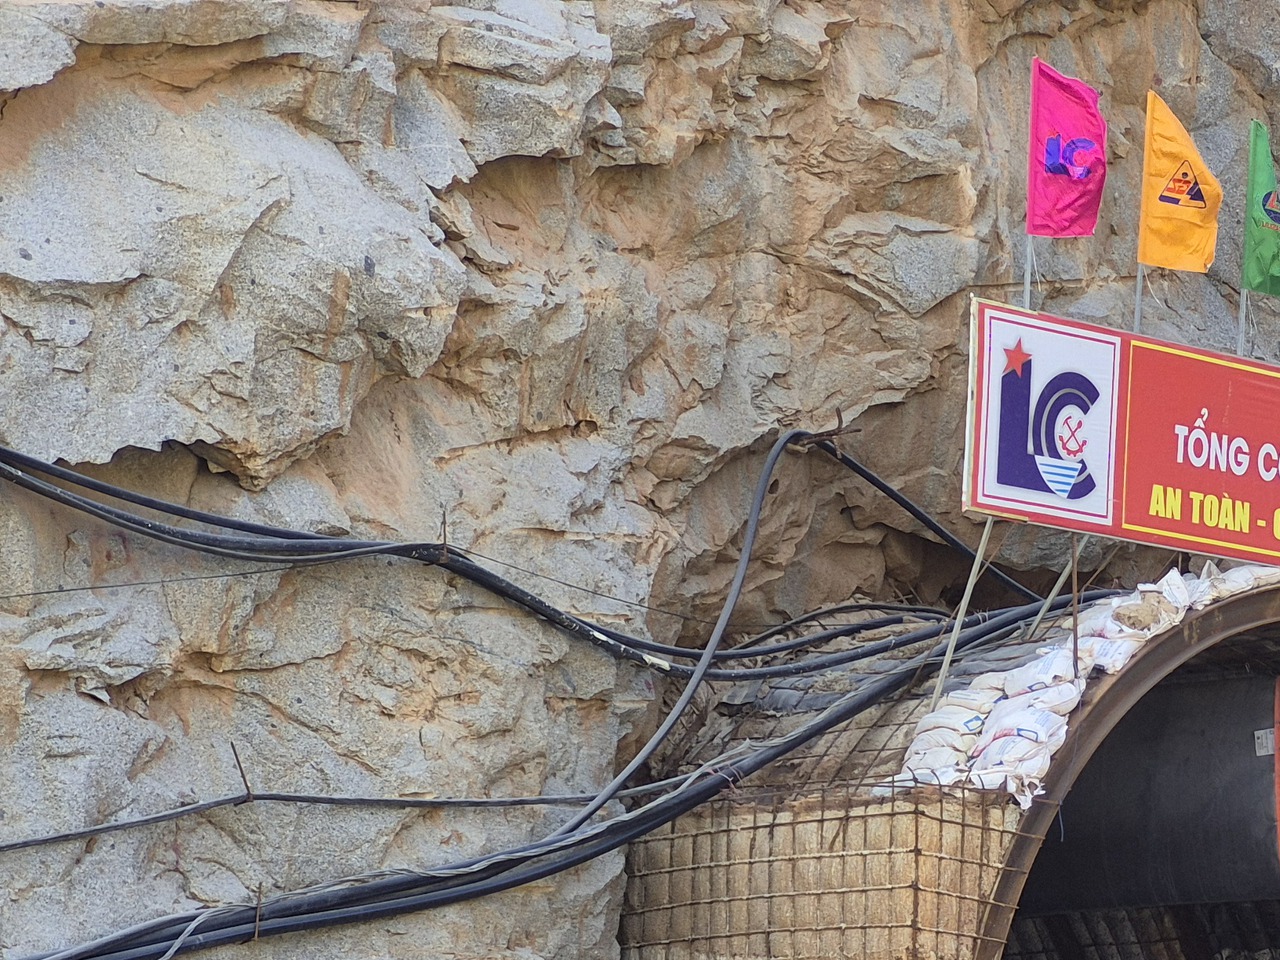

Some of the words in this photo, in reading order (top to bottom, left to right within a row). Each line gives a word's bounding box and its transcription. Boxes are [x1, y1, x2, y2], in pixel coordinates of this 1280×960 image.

[1174, 407, 1250, 476] TỔNG
[1149, 484, 1182, 521] AN
[1189, 492, 1250, 534] TOÀN
